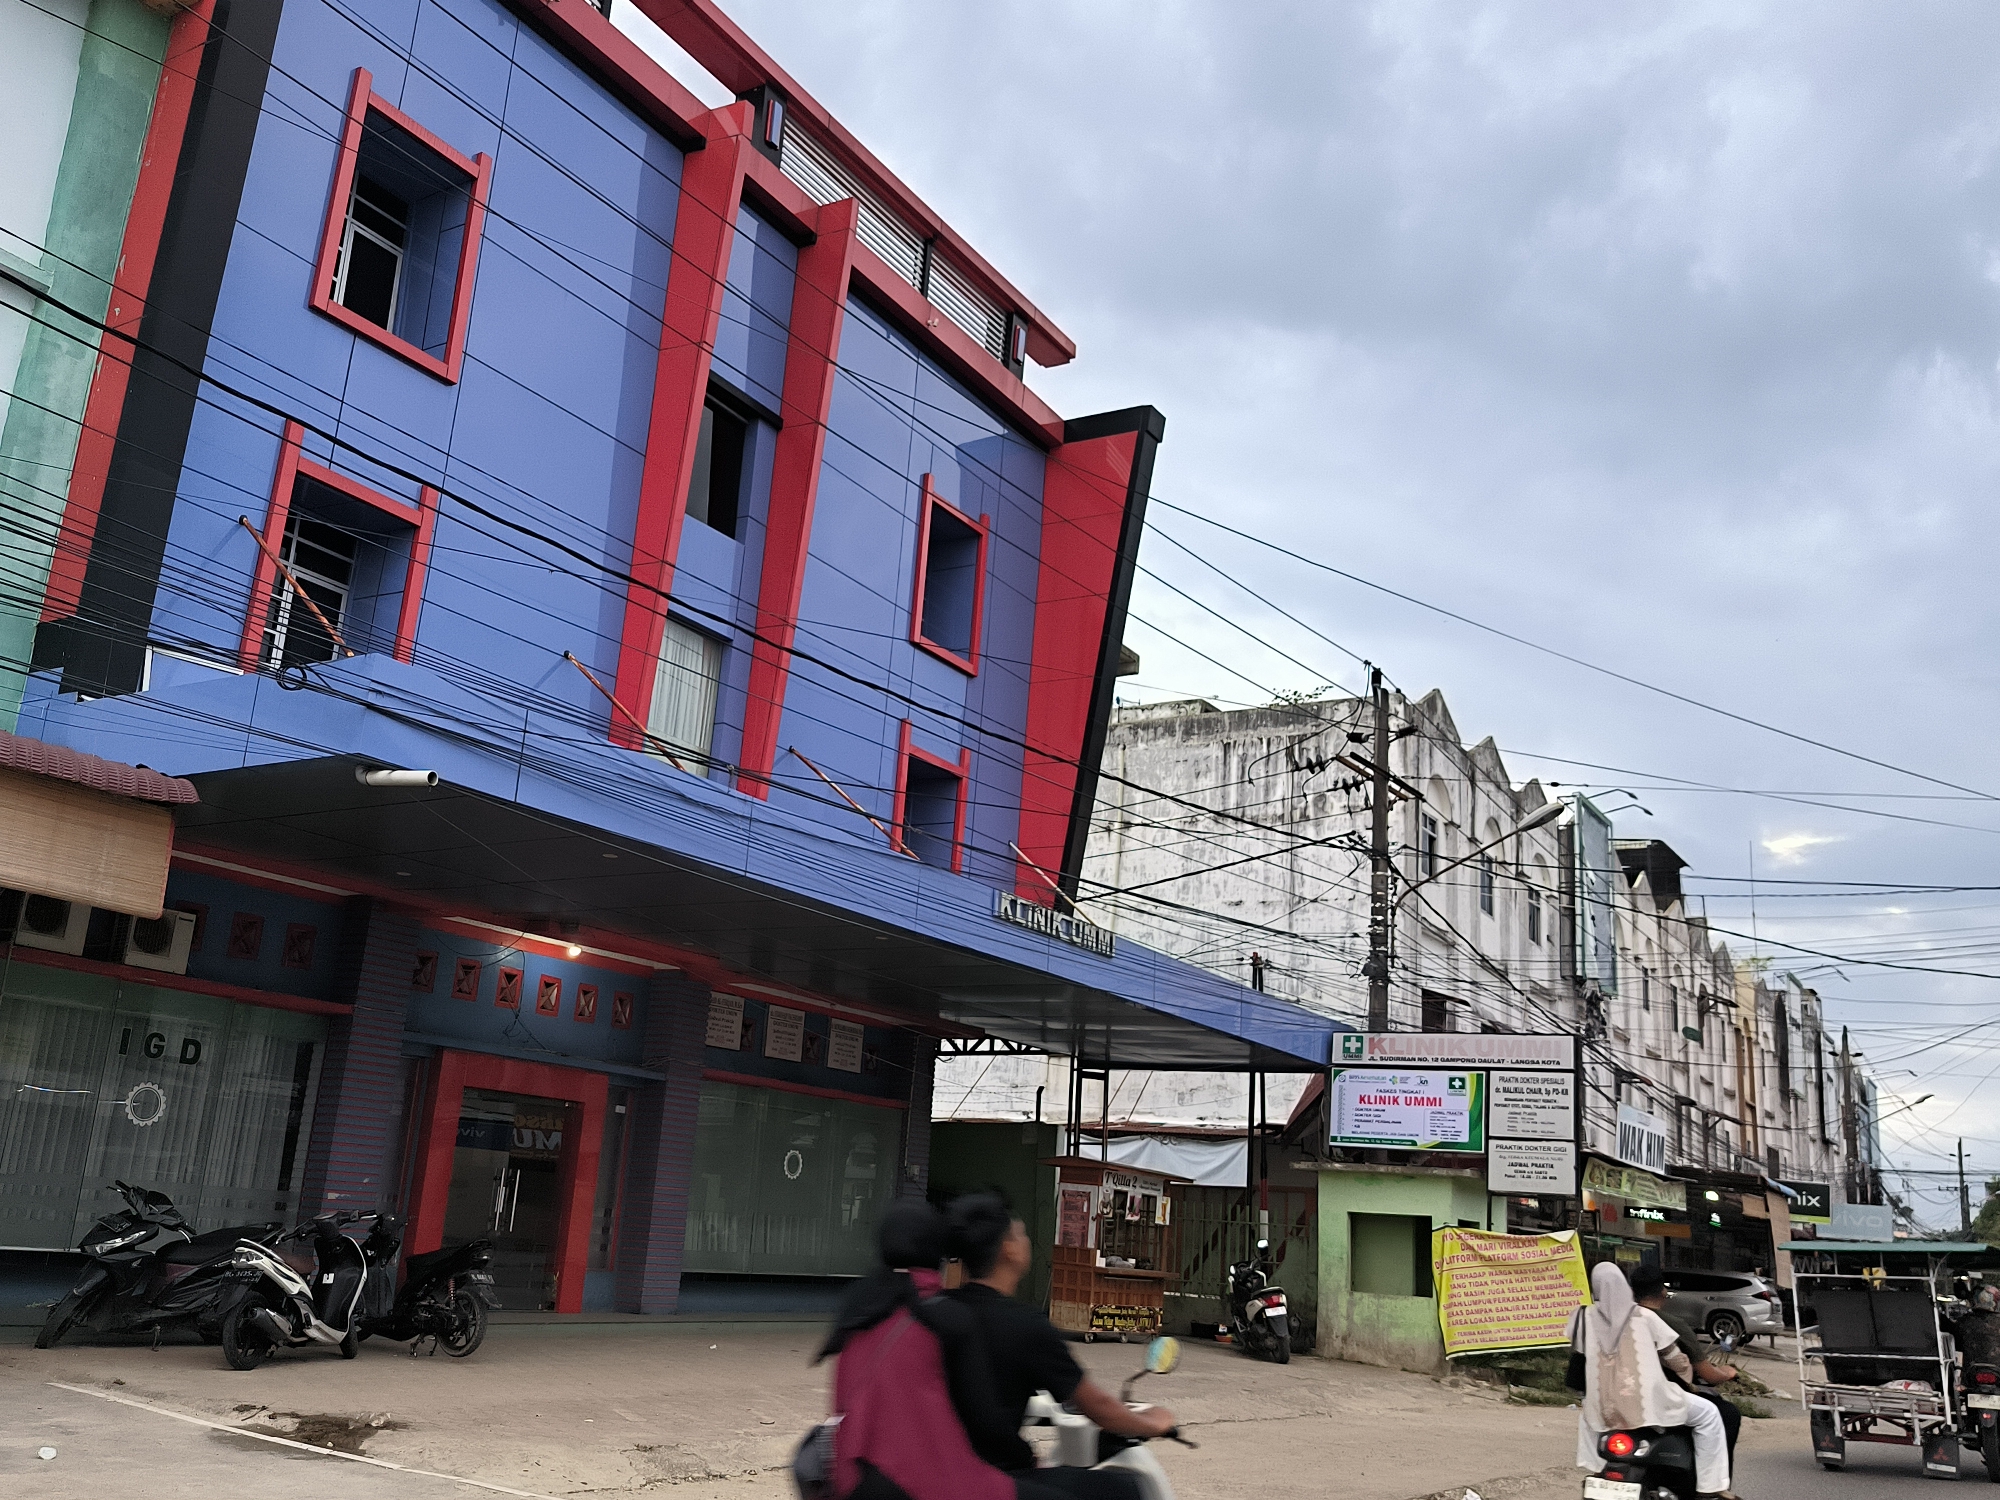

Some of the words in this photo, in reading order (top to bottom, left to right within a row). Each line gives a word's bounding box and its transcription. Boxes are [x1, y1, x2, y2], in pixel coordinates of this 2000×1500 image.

[1001, 892, 1072, 941] KLINIK
[118, 1027, 202, 1065] IGD
[1368, 1036, 1468, 1056] KLINIK
[1475, 1038, 1562, 1059] UMMI
[1359, 1094, 1400, 1106] KLINIK
[1405, 1096, 1442, 1107] UMMI
[1495, 1143, 1523, 1151] PRAKTIK
[1619, 1121, 1644, 1165] WAK
[1645, 1131, 1665, 1174] HIM
[1476, 1242, 1496, 1251] MARI
[1498, 1239, 1539, 1250] VIRALKAN
[1520, 1249, 1549, 1259] SOSIAL
[1549, 1243, 1575, 1255] MEDIA
[1451, 1271, 1486, 1281] TERHADAP
[1487, 1269, 1513, 1277] WARGA
[1513, 1264, 1558, 1275] MASYARAKAT
[1468, 1280, 1489, 1288] TIDAK
[1491, 1278, 1514, 1286] PUNYA
[1514, 1276, 1531, 1284] HATI
[1547, 1273, 1565, 1281] IMAN
[1463, 1289, 1486, 1298] MASIH
[1488, 1288, 1506, 1296] JUGA
[1507, 1286, 1533, 1294] SELALU
[1534, 1282, 1573, 1291] MEMBUANG
[1530, 1292, 1556, 1301] RUMAH
[1556, 1290, 1584, 1298] TANGGA
[1465, 1307, 1493, 1316] DAMPAK
[1469, 1316, 1495, 1324] LOKASI
[1496, 1314, 1511, 1322] DAN
[1512, 1311, 1552, 1321] SEPANJANG
